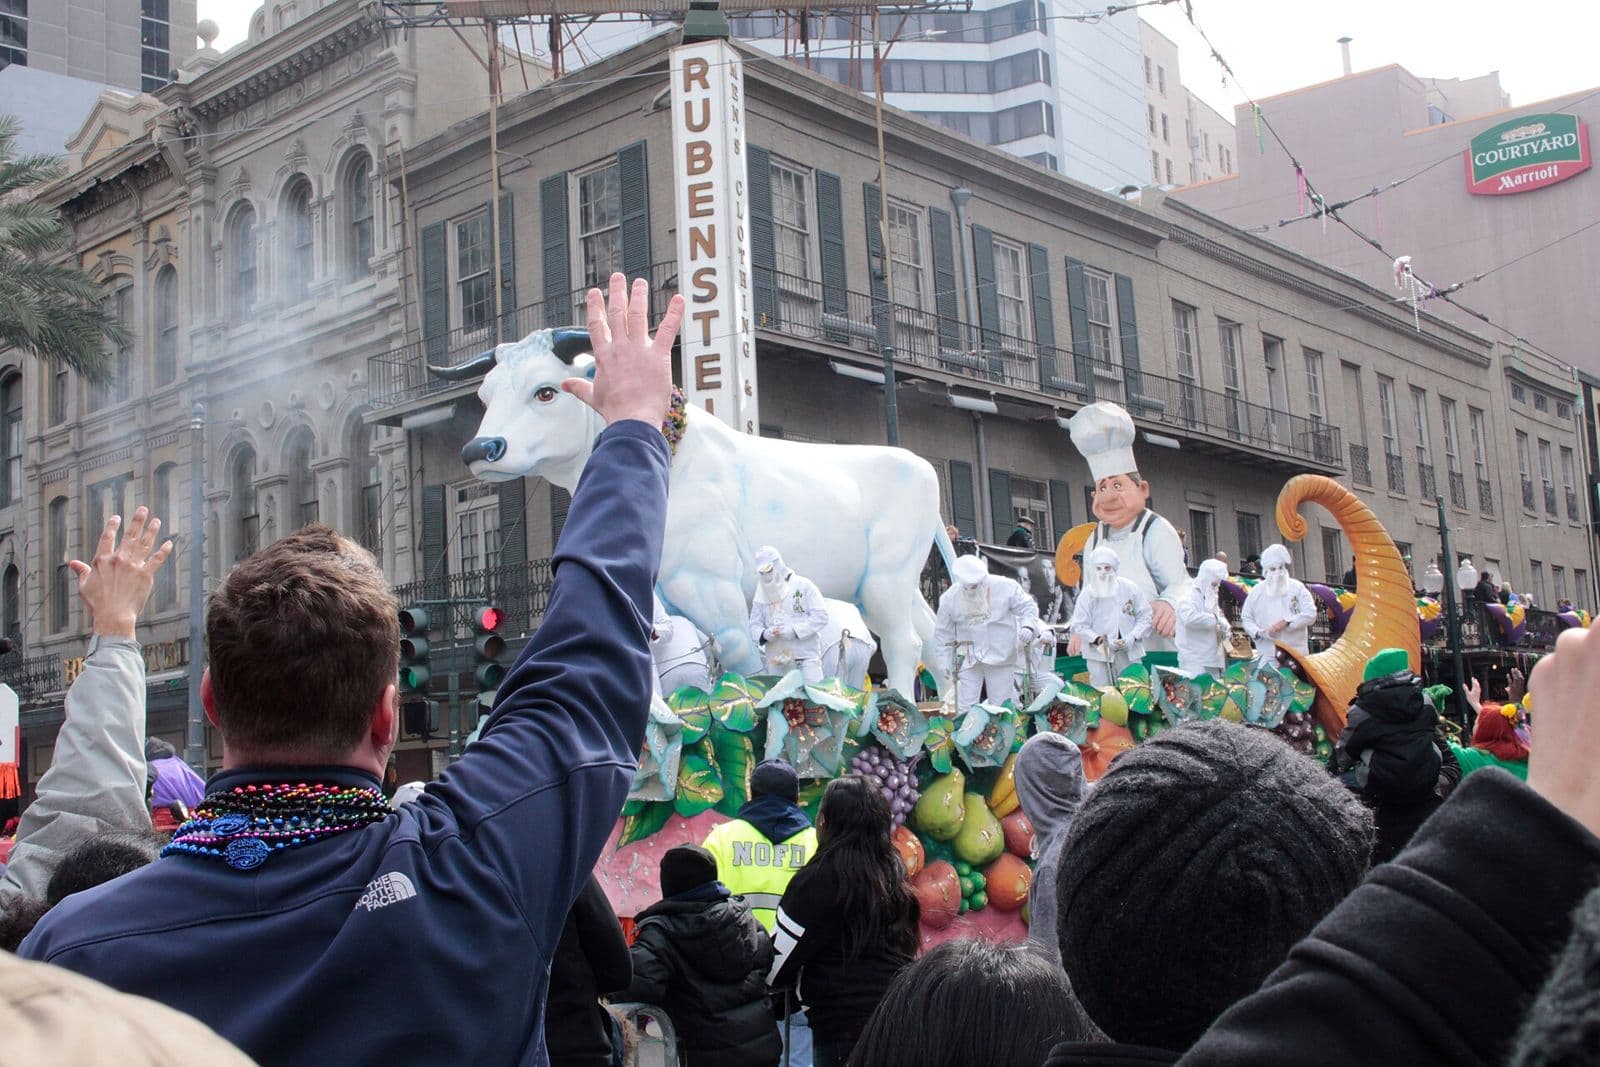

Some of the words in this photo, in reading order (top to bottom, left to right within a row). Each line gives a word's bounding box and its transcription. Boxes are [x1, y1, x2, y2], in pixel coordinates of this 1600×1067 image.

[1474, 132, 1577, 166] COURTYARD
[1498, 164, 1559, 191] Marriott
[729, 59, 740, 155] MEN'S
[735, 180, 750, 358] CLOTHING
[732, 841, 806, 868] NOFD
[366, 873, 391, 891] THE
[355, 883, 394, 910] NORTH
[365, 892, 397, 912] FACE
